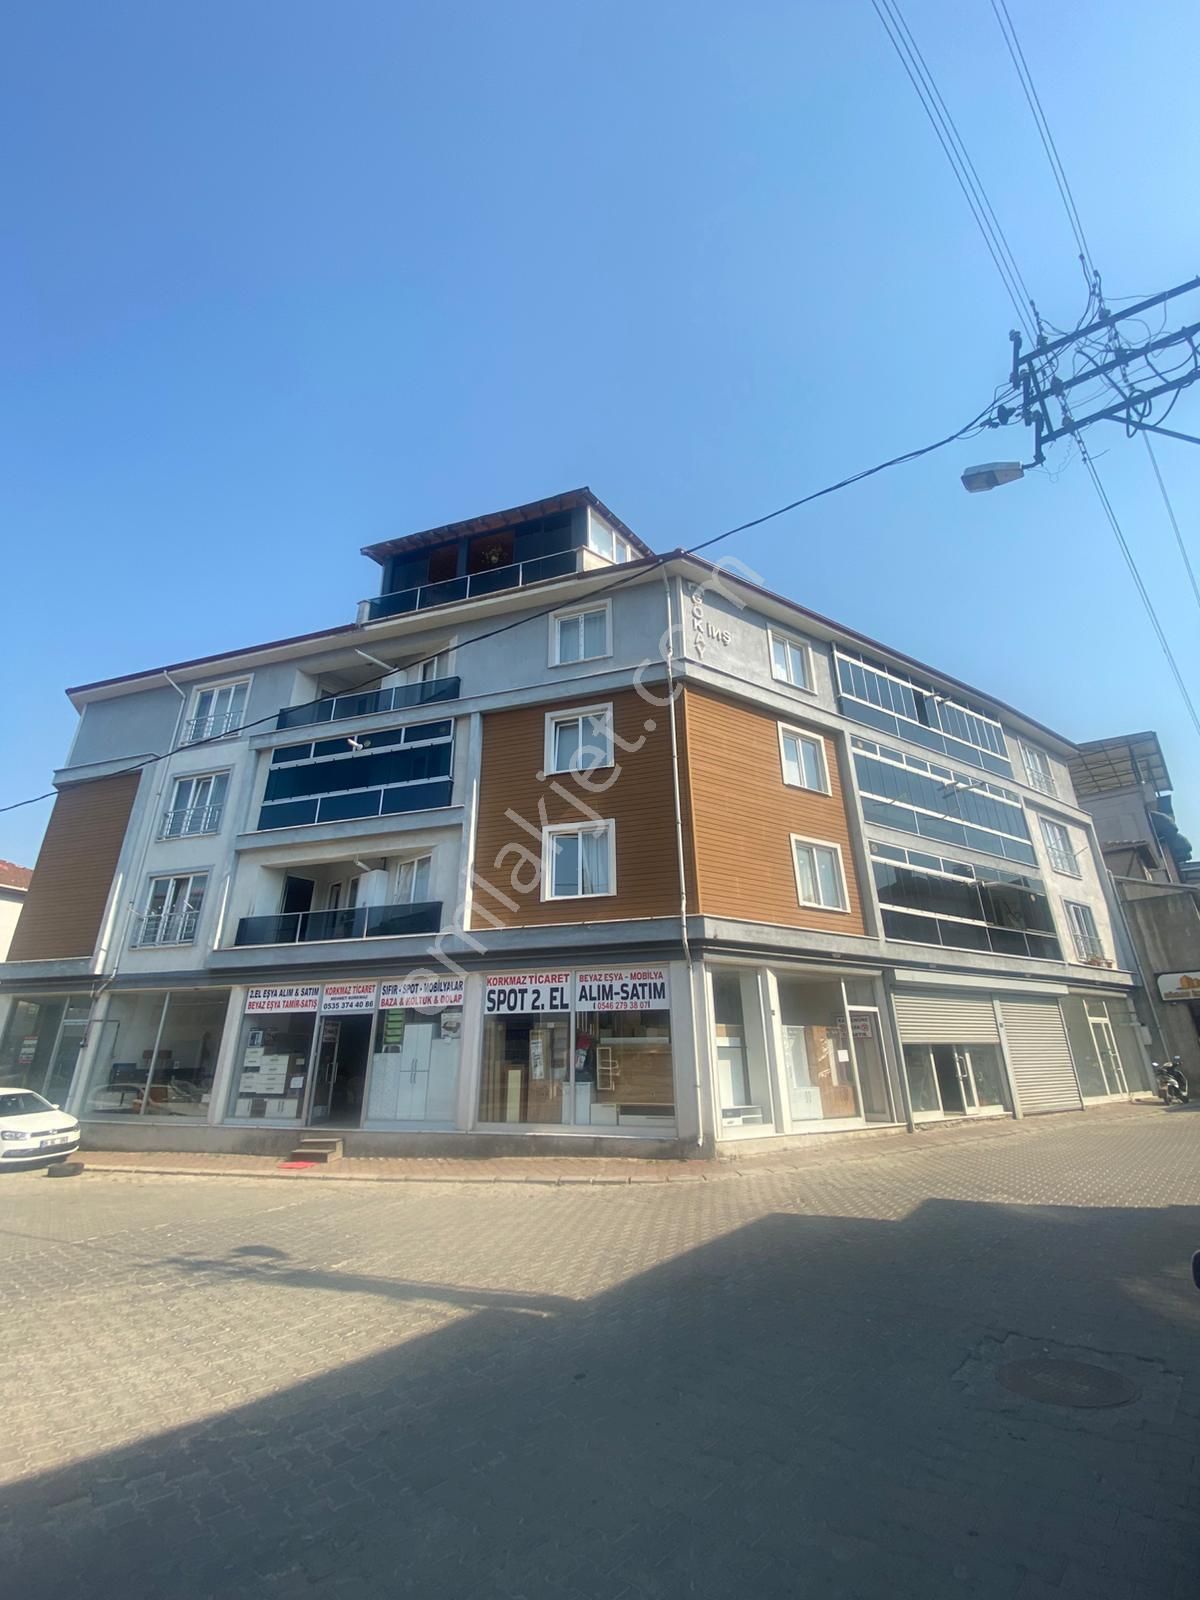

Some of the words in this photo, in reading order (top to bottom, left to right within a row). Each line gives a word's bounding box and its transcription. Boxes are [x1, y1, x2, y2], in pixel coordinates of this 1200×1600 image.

[487, 975, 527, 986] KORKMAZ
[529, 972, 570, 984] TİCARET
[579, 973, 602, 983] BEYAZ
[604, 972, 624, 983] EŞYA
[630, 970, 664, 981] MOBİLYA
[263, 988, 278, 999] EŞYA
[279, 988, 294, 998] ALIM
[301, 986, 319, 997] SATIM
[326, 985, 352, 996] KORKMAZ
[353, 983, 376, 995] TİCARET
[382, 984, 398, 996] SIFIR
[402, 983, 419, 994] SPOT
[423, 979, 464, 993] MOBİLYALAR
[578, 981, 666, 1002] ALIM-SATIM
[247, 1000, 266, 1010] BEYAZ
[266, 1000, 281, 1010] EŞYA
[381, 997, 398, 1007] BAZA
[405, 995, 431, 1006] KOLTUK
[440, 993, 463, 1004] DOLAP
[487, 988, 528, 1012] SPOT
[531, 989, 545, 1011] 2.
[549, 986, 570, 1010] EL
[323, 1002, 340, 1010] 0535
